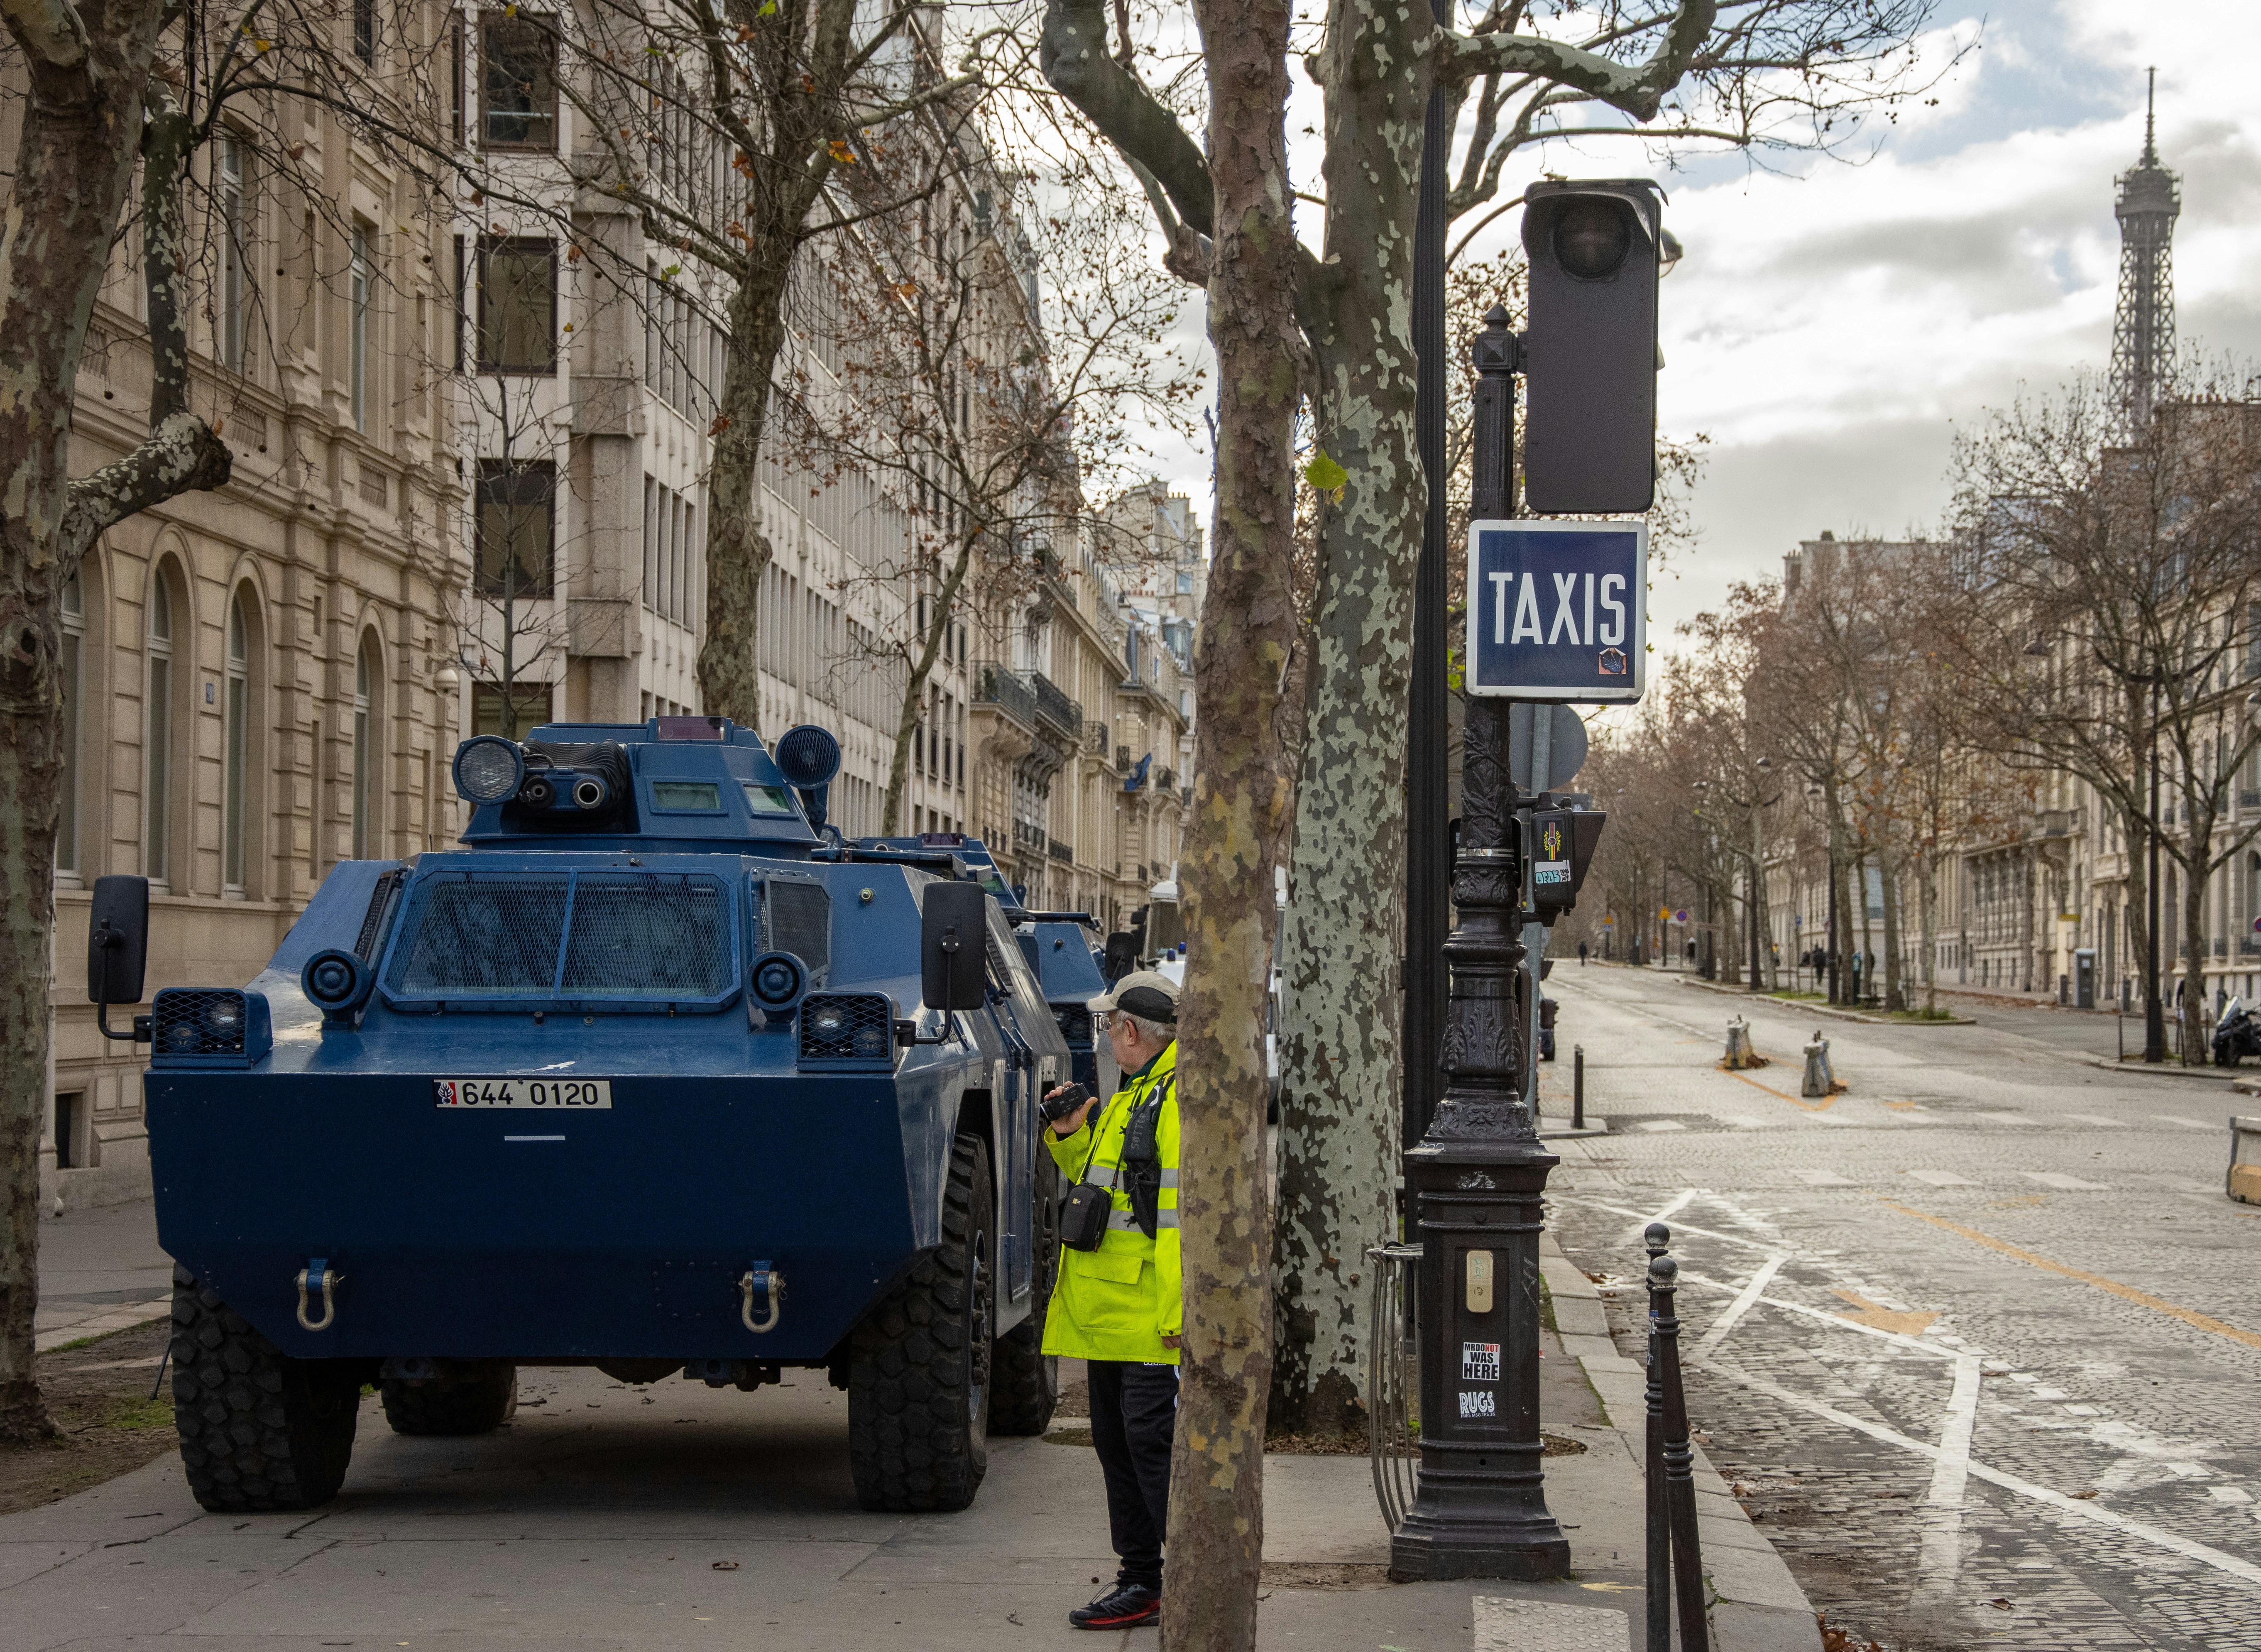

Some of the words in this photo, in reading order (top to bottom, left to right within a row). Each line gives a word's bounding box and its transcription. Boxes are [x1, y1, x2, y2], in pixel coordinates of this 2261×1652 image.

[1489, 572, 1625, 646] TAXIS
[462, 1082, 513, 1105] 644
[530, 1082, 598, 1105] 0120
[1464, 1343, 1499, 1352] MRDONOT
[1470, 1352, 1494, 1363] WAS
[1463, 1363, 1498, 1380] HERE
[1459, 1391, 1495, 1414] RUGS
